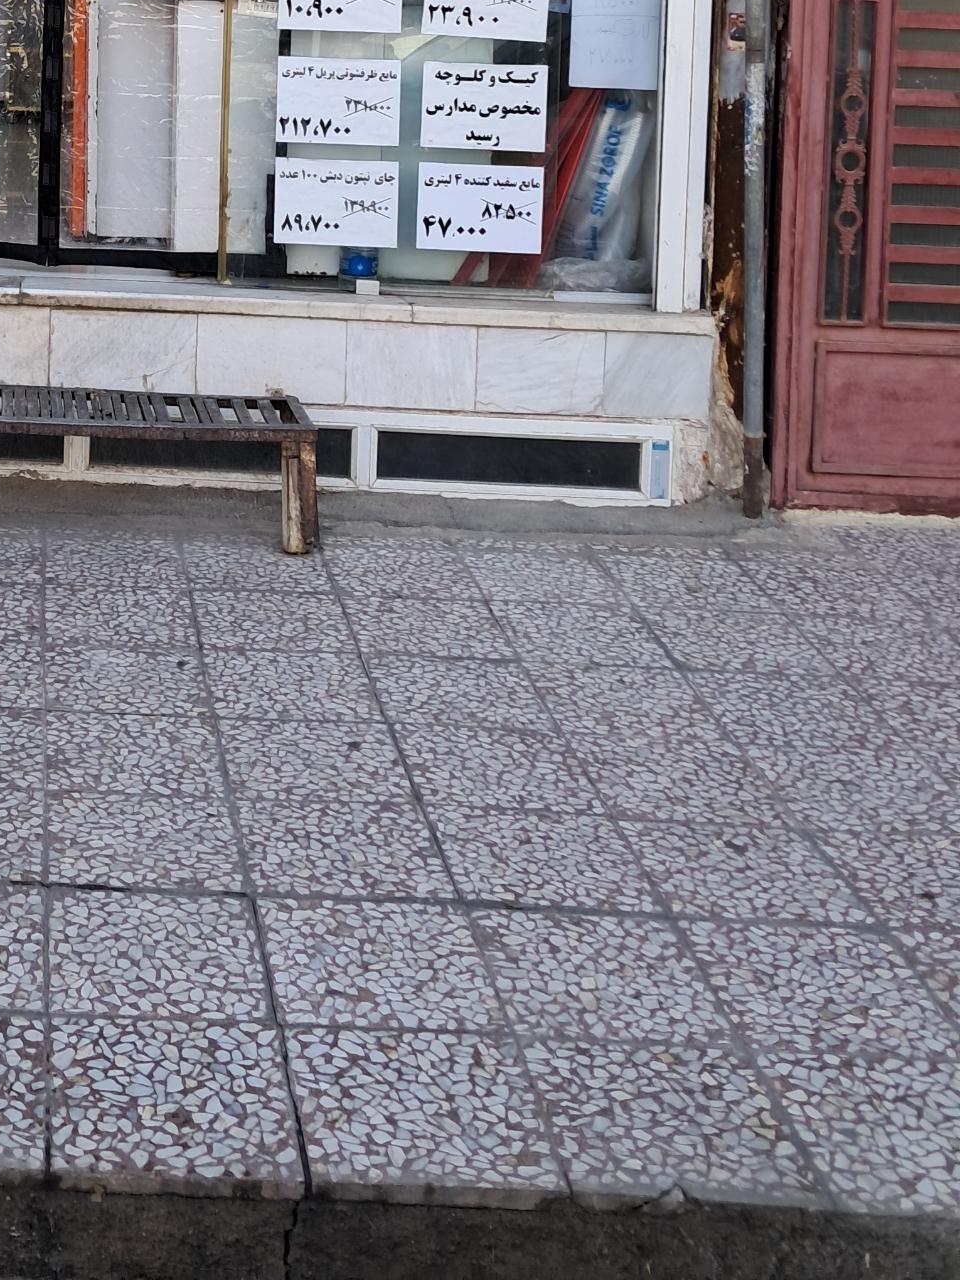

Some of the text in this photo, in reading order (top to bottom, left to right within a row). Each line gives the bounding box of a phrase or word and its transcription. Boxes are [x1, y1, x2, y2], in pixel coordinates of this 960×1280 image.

[281, 66, 398, 83] مایع لیتری
[425, 97, 542, 120] مخصوص مدارس
[465, 129, 501, 148] رسید
[279, 170, 299, 179] عدد
[301, 169, 318, 180] ۱۰۰
[373, 172, 396, 186] چای
[423, 173, 541, 192] مایع سفید کننده لیتری
[590, 179, 610, 217] SINA
